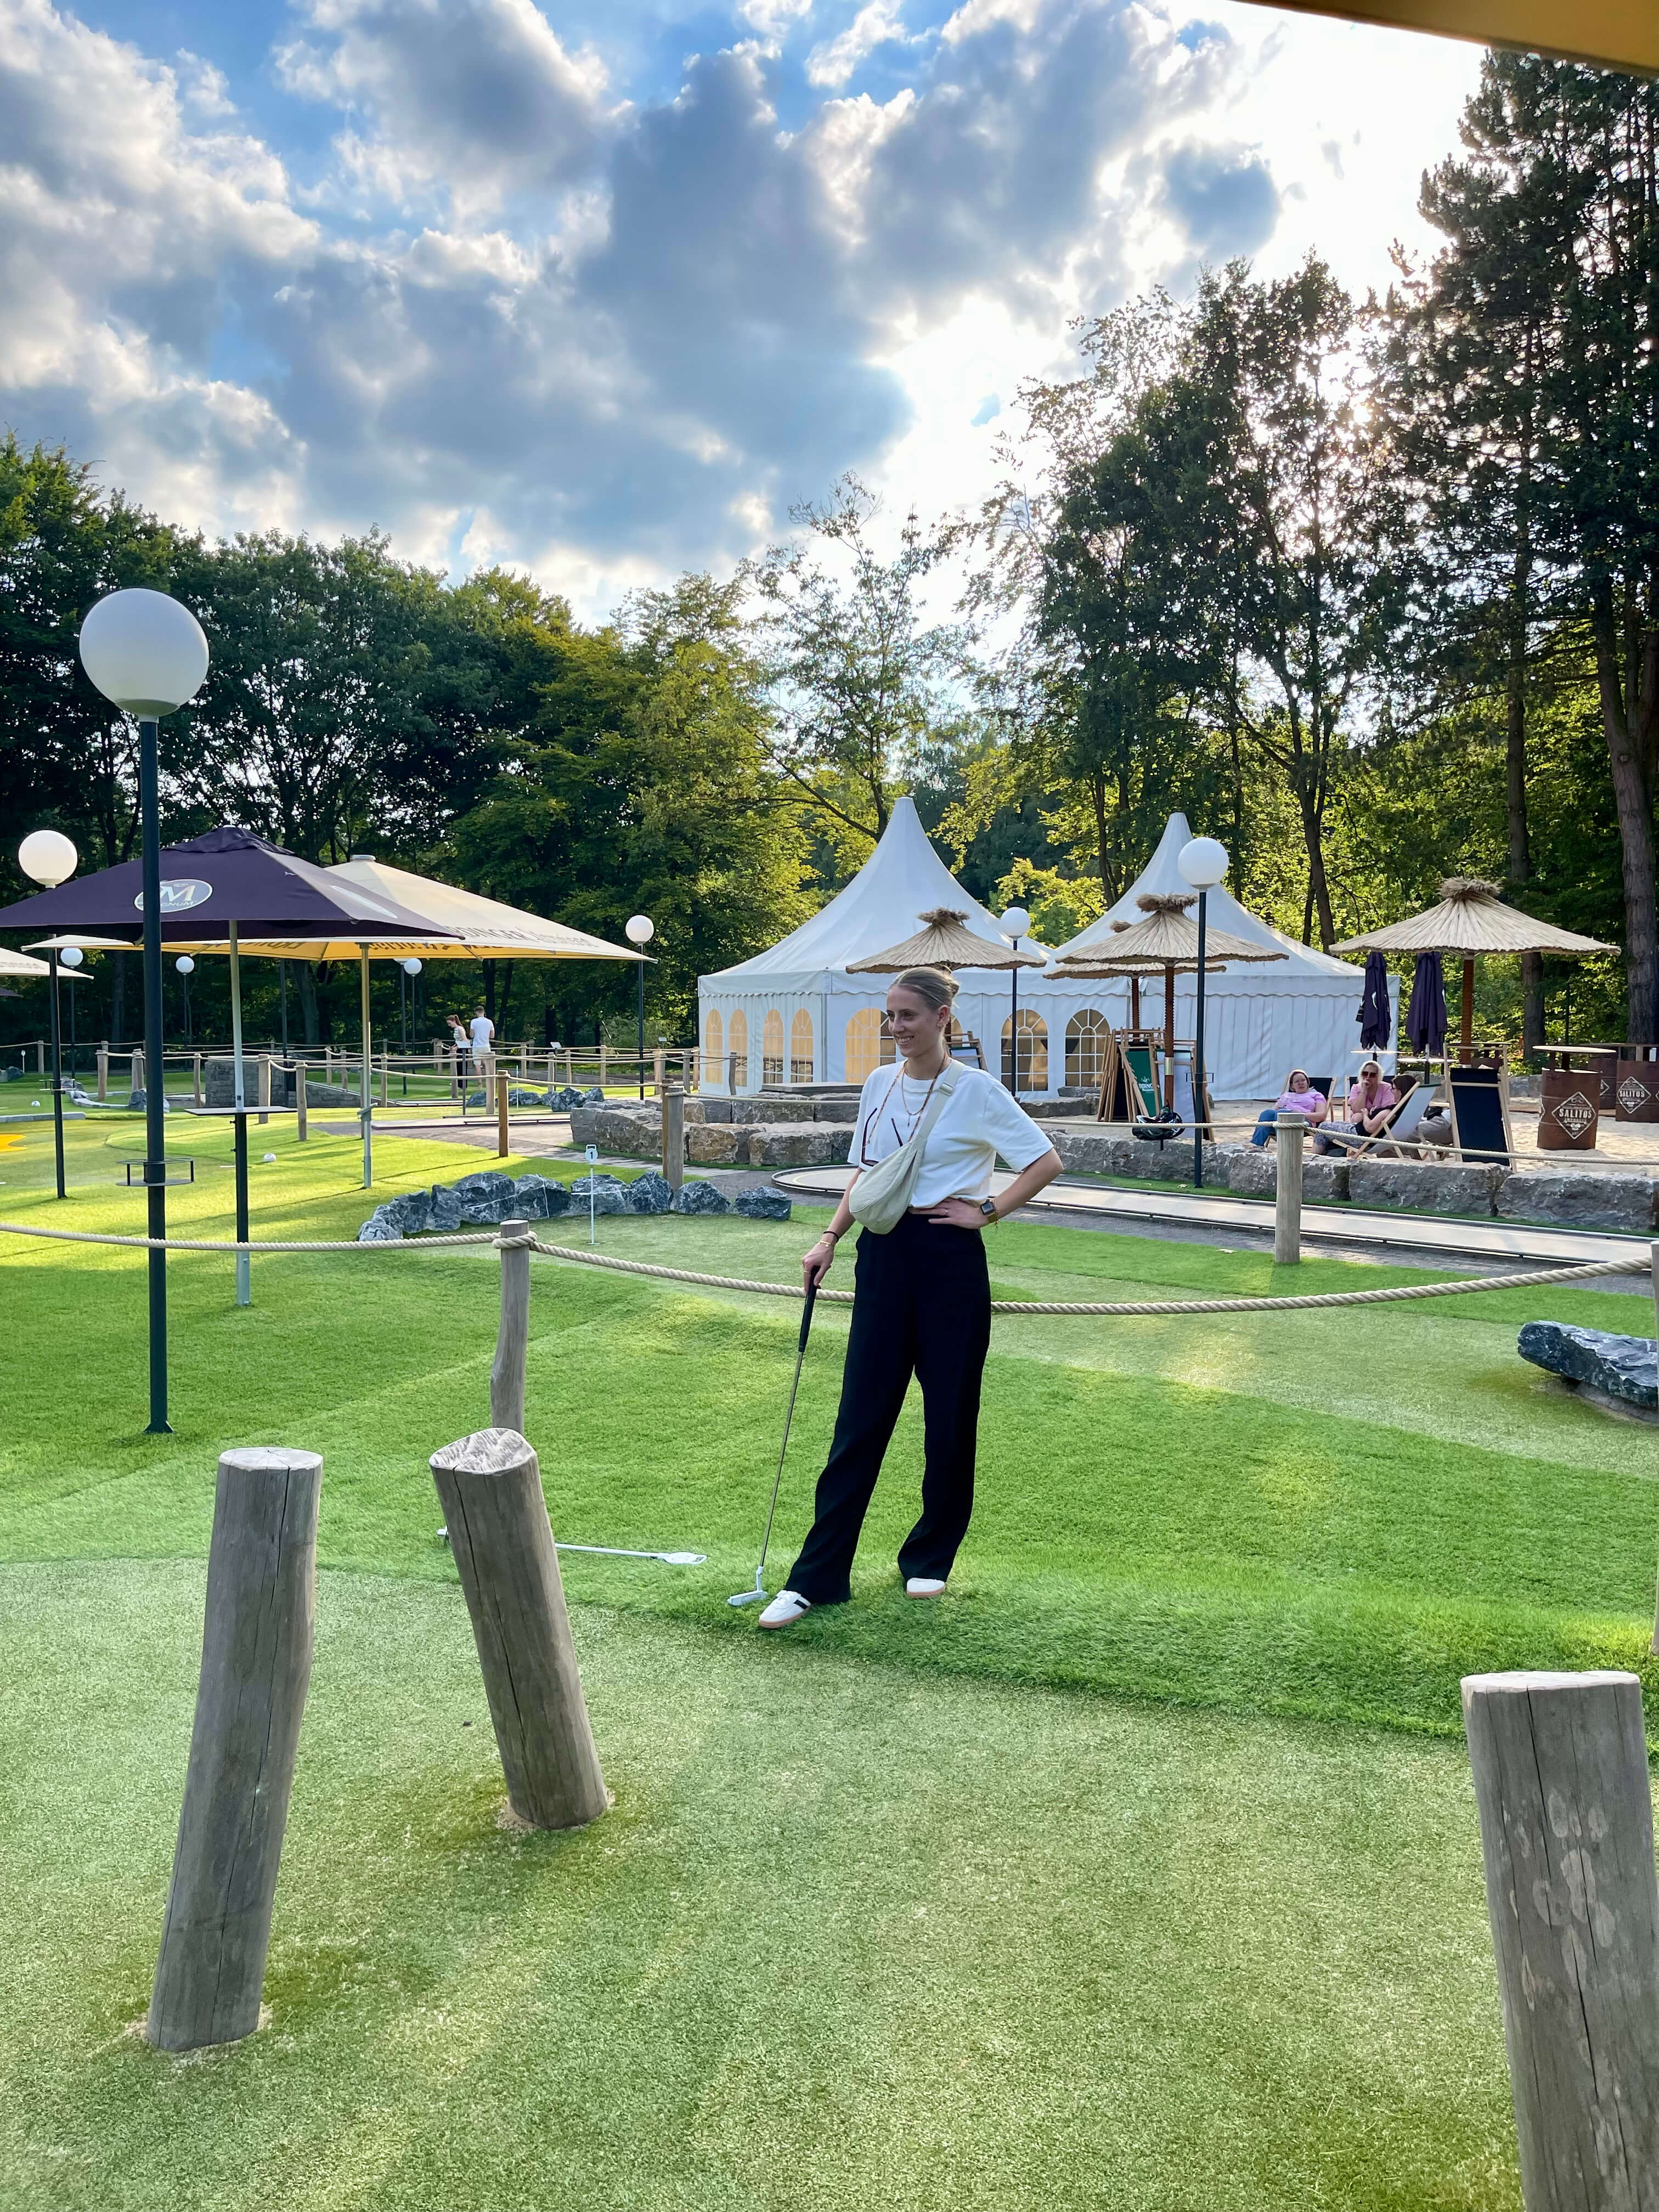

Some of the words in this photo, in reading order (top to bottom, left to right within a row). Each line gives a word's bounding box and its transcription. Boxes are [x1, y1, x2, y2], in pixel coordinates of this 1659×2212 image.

[443, 926, 537, 943] RDINGER
[1559, 1108, 1592, 1119] SALITOS
[590, 1151, 593, 1159] 1
